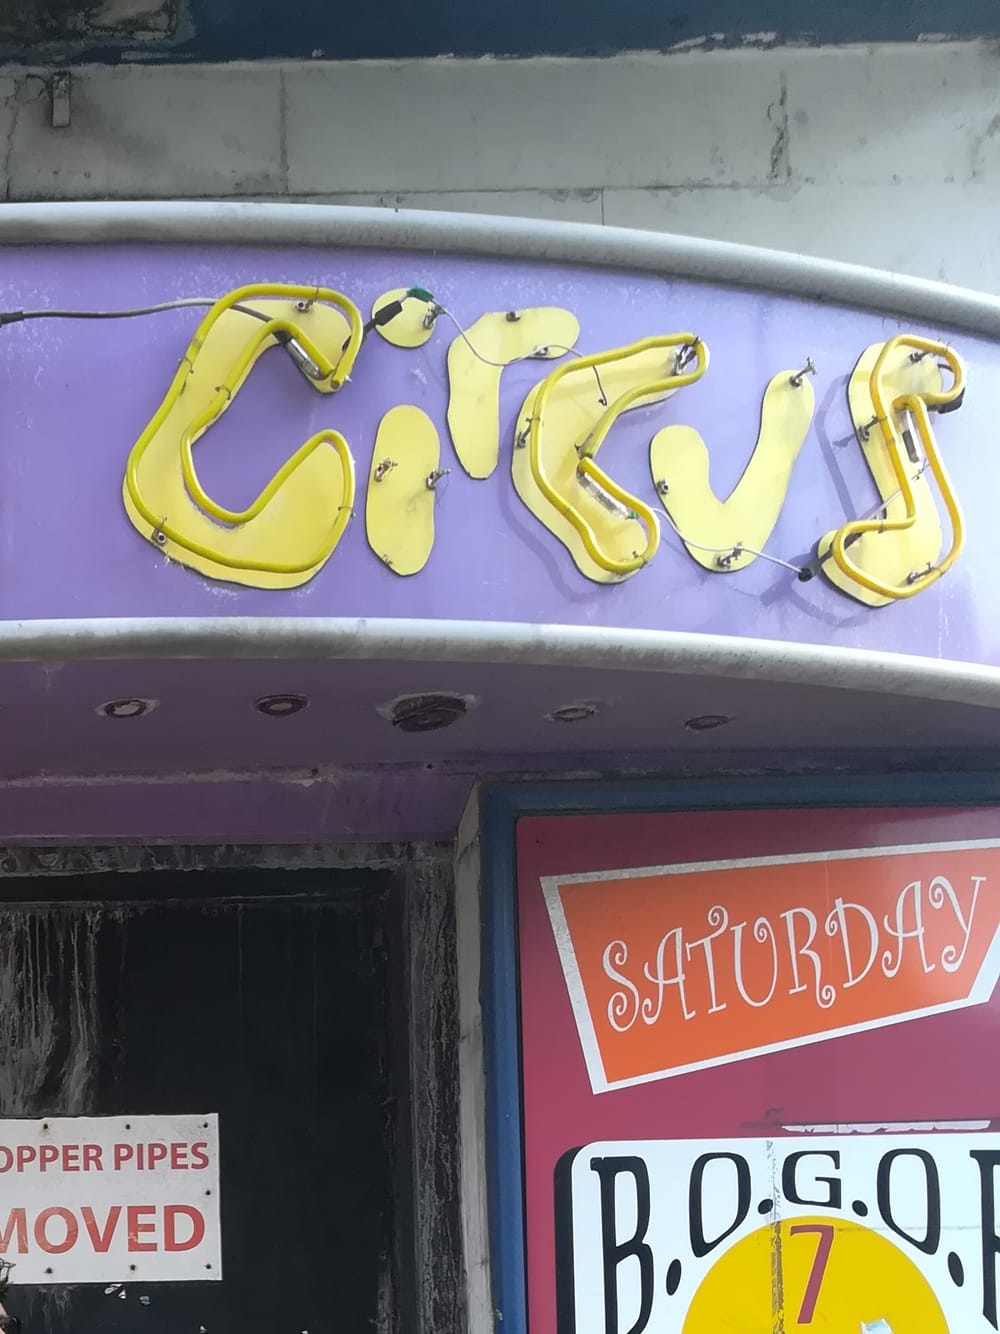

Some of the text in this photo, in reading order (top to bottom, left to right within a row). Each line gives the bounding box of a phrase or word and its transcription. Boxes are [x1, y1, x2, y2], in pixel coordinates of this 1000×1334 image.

[603, 876, 986, 1032] SATURDAY
[113, 1141, 209, 1172] PIPES
[789, 1224, 835, 1324] 7
